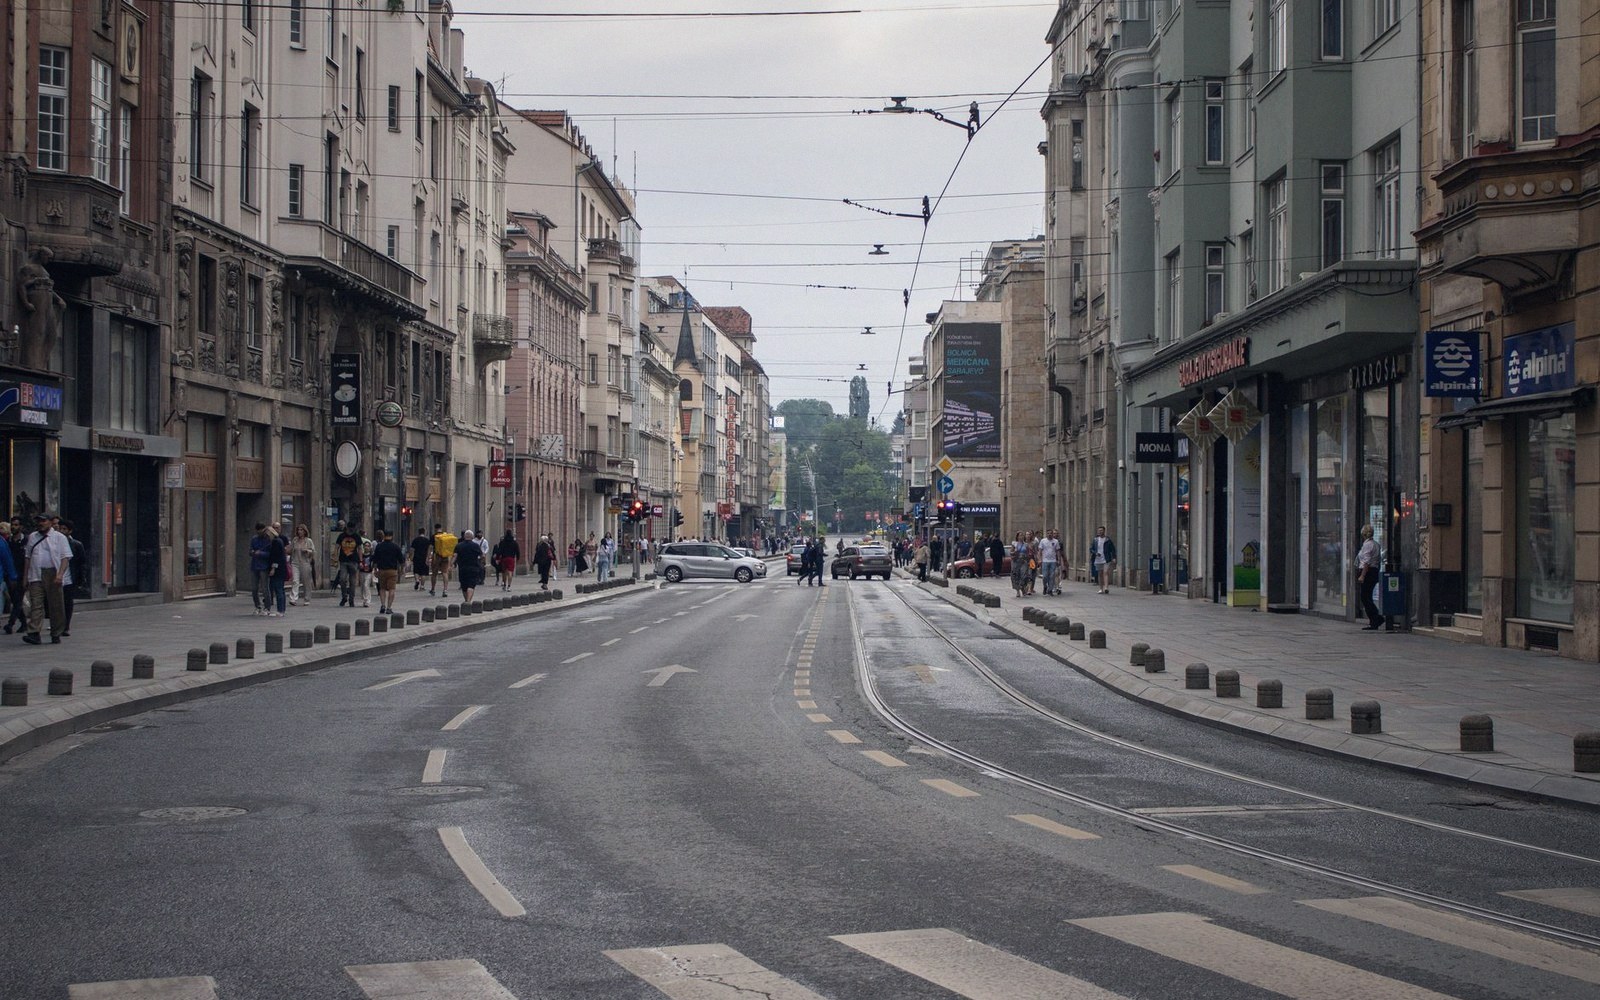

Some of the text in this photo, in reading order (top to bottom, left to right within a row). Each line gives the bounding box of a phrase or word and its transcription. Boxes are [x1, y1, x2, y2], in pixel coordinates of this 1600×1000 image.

[947, 349, 977, 357] BOLNICA
[947, 358, 990, 366] MEDICANA
[1522, 349, 1566, 385] alpina
[947, 367, 984, 375] SARAJEVO
[1348, 356, 1397, 389] BARBOSA
[1430, 380, 1476, 392] alpina
[1139, 443, 1172, 453] MONA
